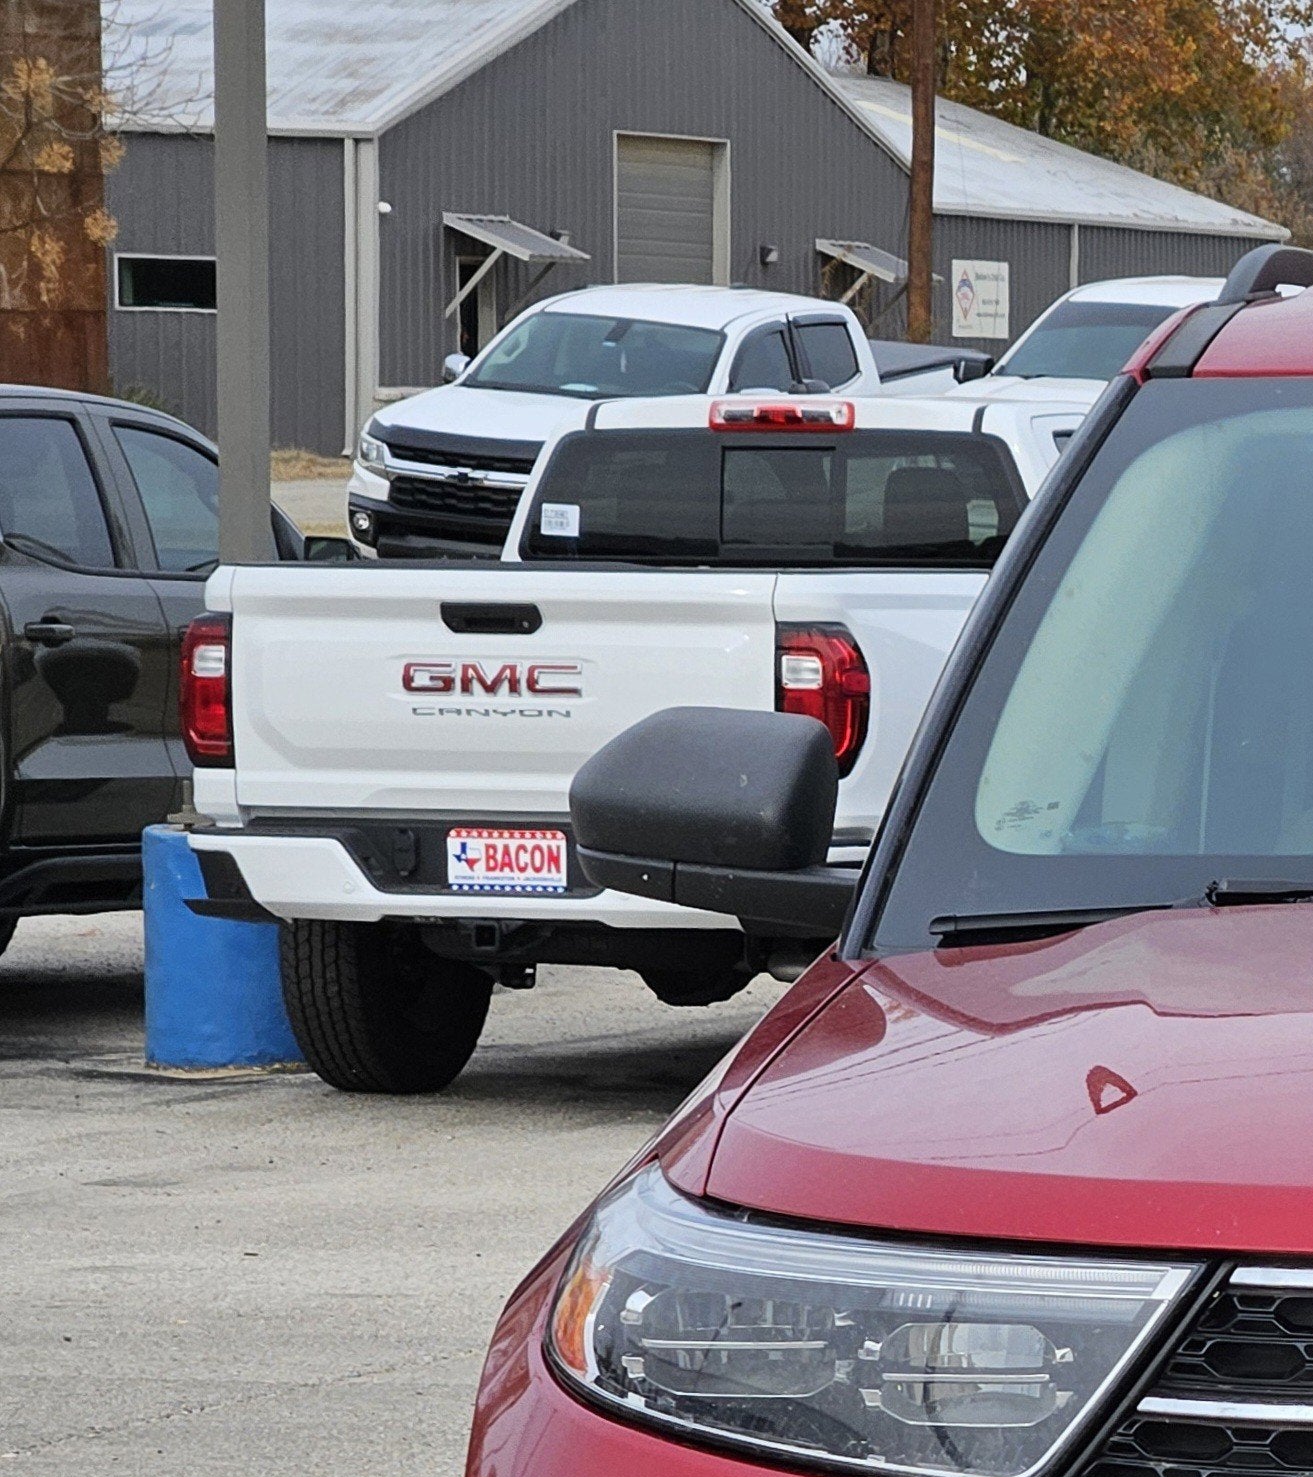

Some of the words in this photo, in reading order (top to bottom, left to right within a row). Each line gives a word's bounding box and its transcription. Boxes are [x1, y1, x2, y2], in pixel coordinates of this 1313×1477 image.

[402, 661, 582, 698] GMC
[412, 707, 571, 718] CANYON
[484, 843, 561, 873] BACON
